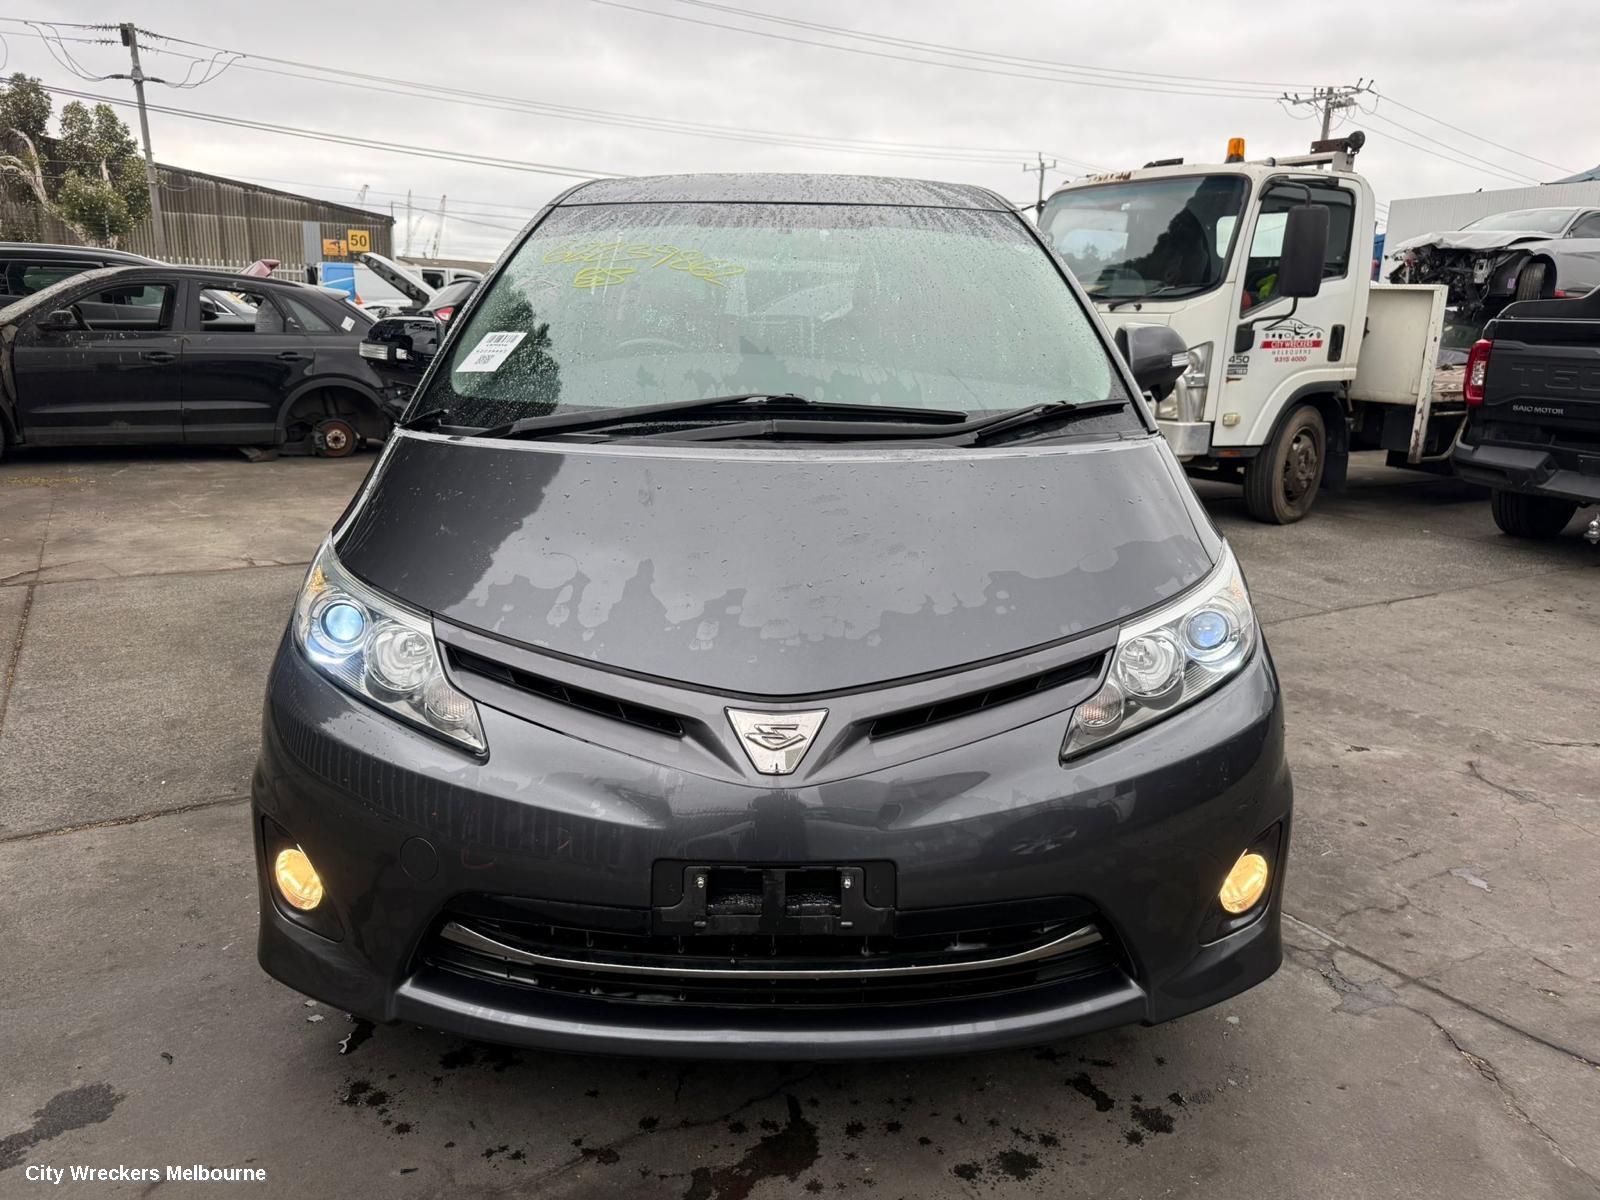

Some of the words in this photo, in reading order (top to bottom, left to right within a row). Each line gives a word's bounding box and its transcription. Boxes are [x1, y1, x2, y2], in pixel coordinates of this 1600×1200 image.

[350, 234, 367, 247] 50
[1271, 340, 1284, 349] CITY
[1285, 340, 1314, 349] WRECKERS
[1228, 355, 1250, 364] 450
[1512, 404, 1533, 413] SAIC
[1533, 406, 1565, 415] MOTOR
